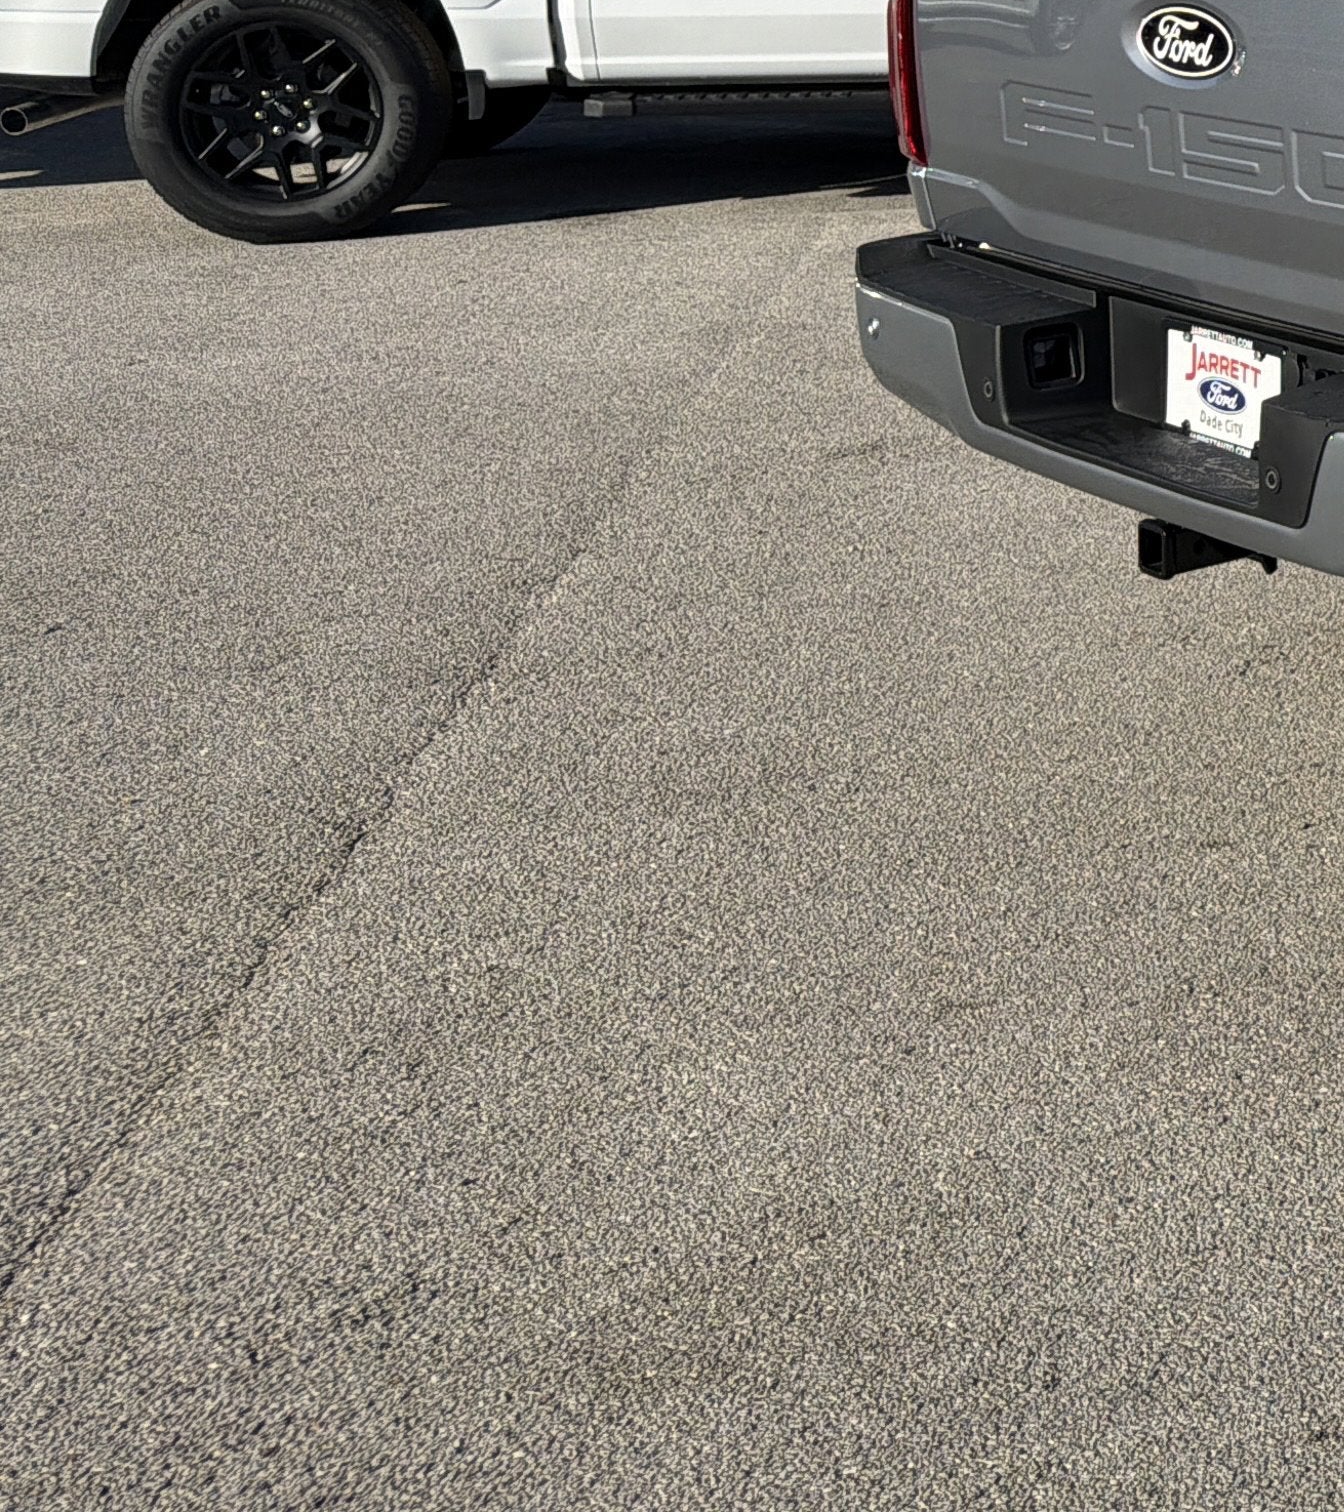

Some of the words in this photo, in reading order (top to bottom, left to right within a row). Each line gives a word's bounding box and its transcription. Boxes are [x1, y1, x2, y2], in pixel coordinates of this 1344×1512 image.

[1153, 14, 1214, 67] Ford
[141, 5, 220, 129] WRANGLER
[1185, 343, 1262, 389] JARRETT
[1206, 381, 1238, 410] Ford
[1200, 410, 1222, 429] Dade
[1225, 419, 1244, 438] City
